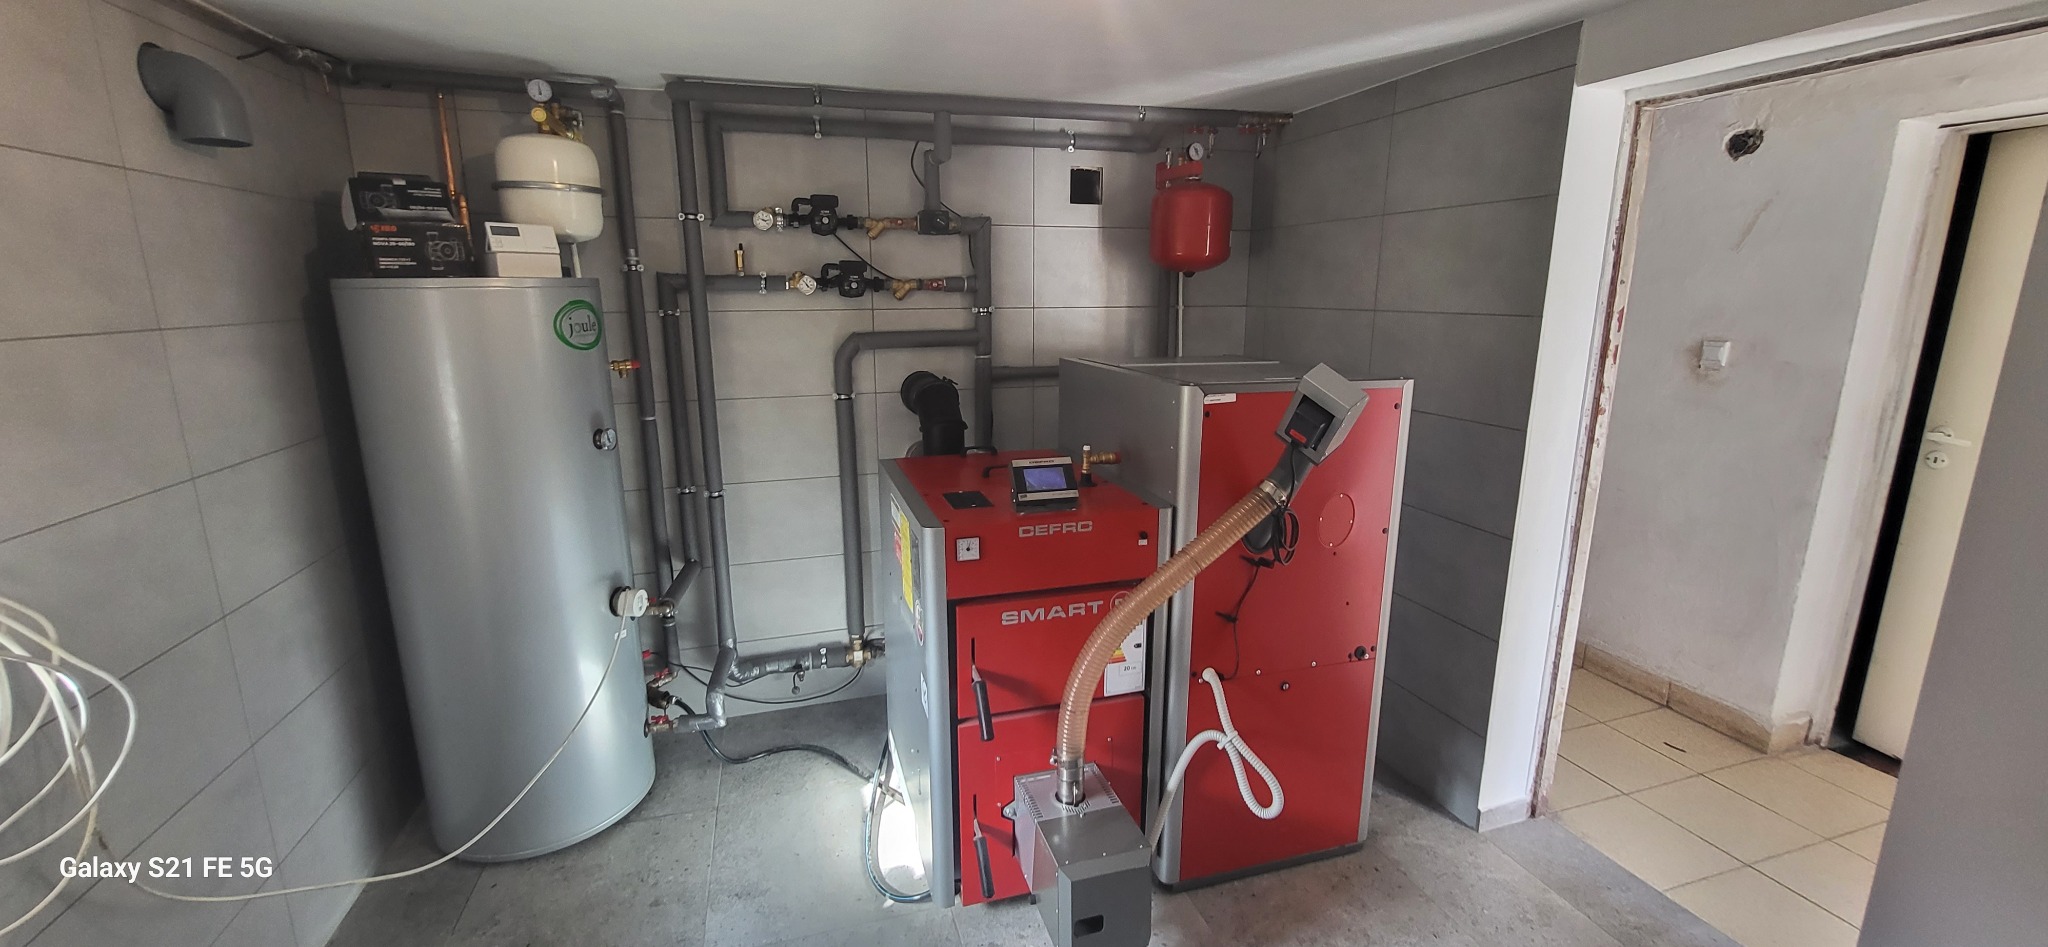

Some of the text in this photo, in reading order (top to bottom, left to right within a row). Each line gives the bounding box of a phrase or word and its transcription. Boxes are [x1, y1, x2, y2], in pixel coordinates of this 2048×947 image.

[568, 314, 596, 338] joule
[1018, 520, 1093, 538] DEFRO
[1002, 600, 1104, 626] SMART
